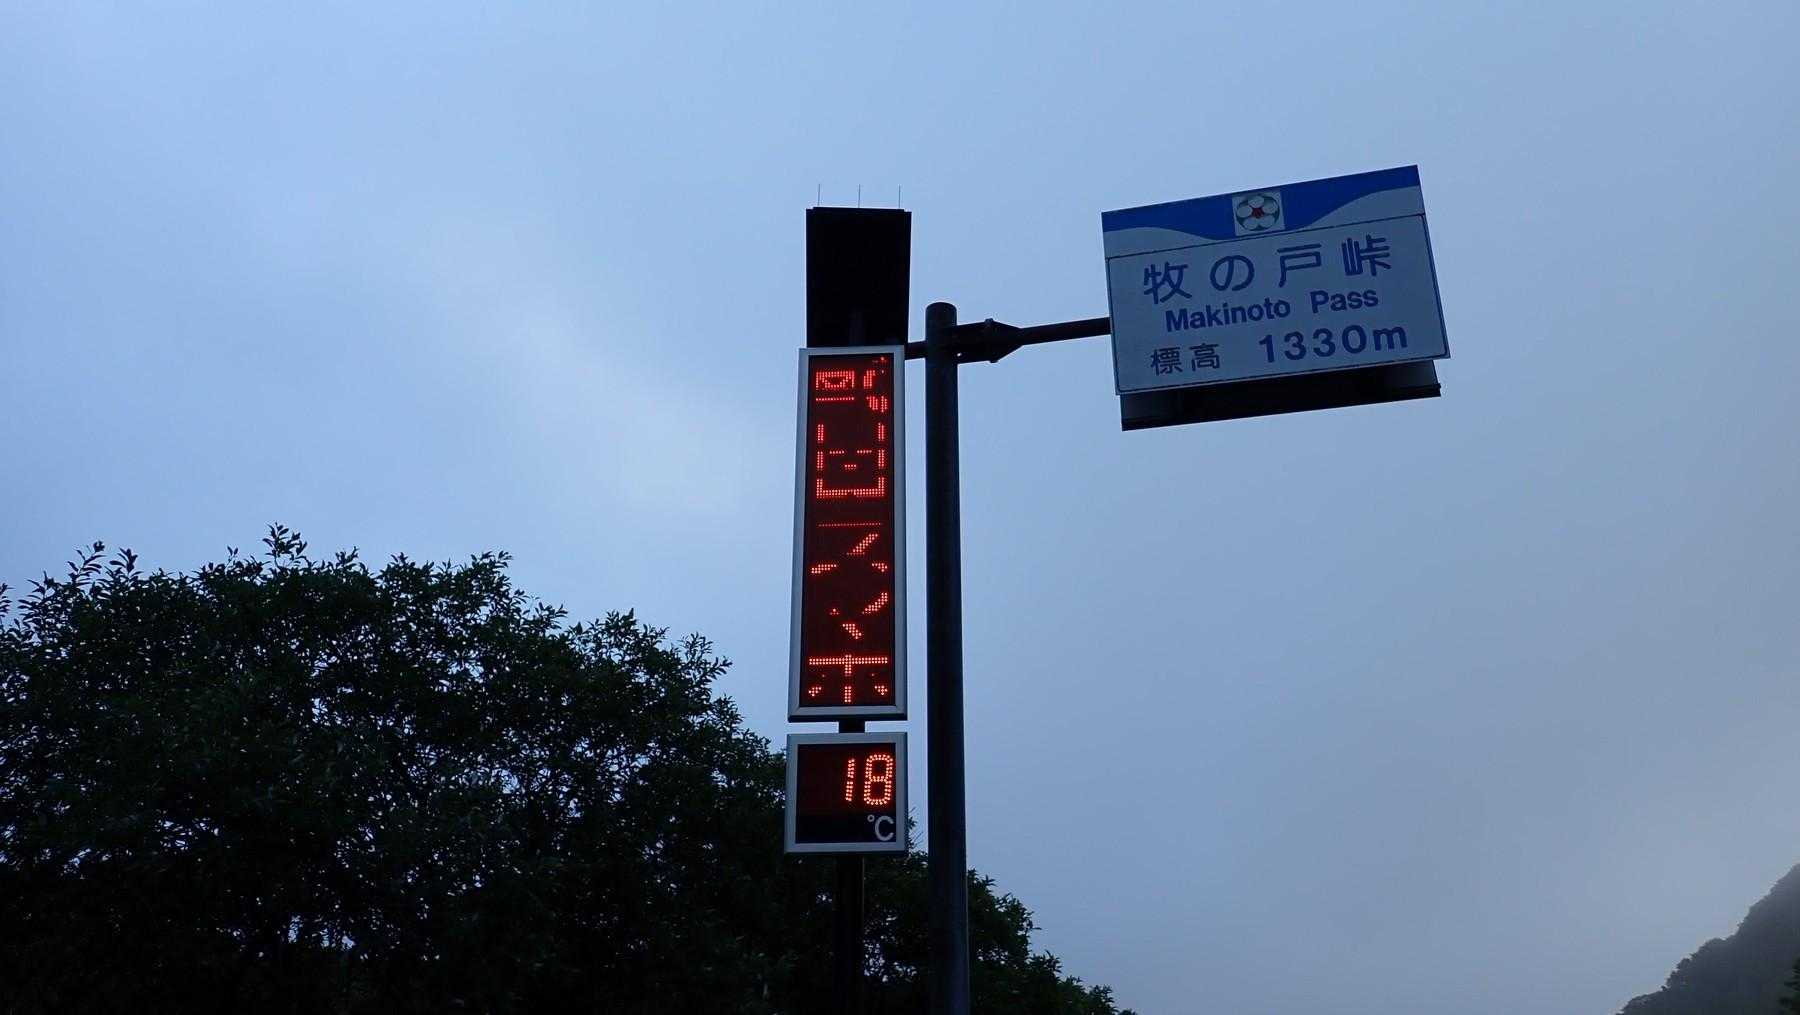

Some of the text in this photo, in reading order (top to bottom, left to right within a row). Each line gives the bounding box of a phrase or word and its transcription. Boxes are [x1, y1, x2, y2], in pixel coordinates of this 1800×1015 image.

[1143, 234, 1392, 305] 牧の戸峠
[1165, 288, 1379, 332] Makinoto Pass
[1150, 324, 1408, 376] 標高 1330m
[845, 754, 893, 805] 18
